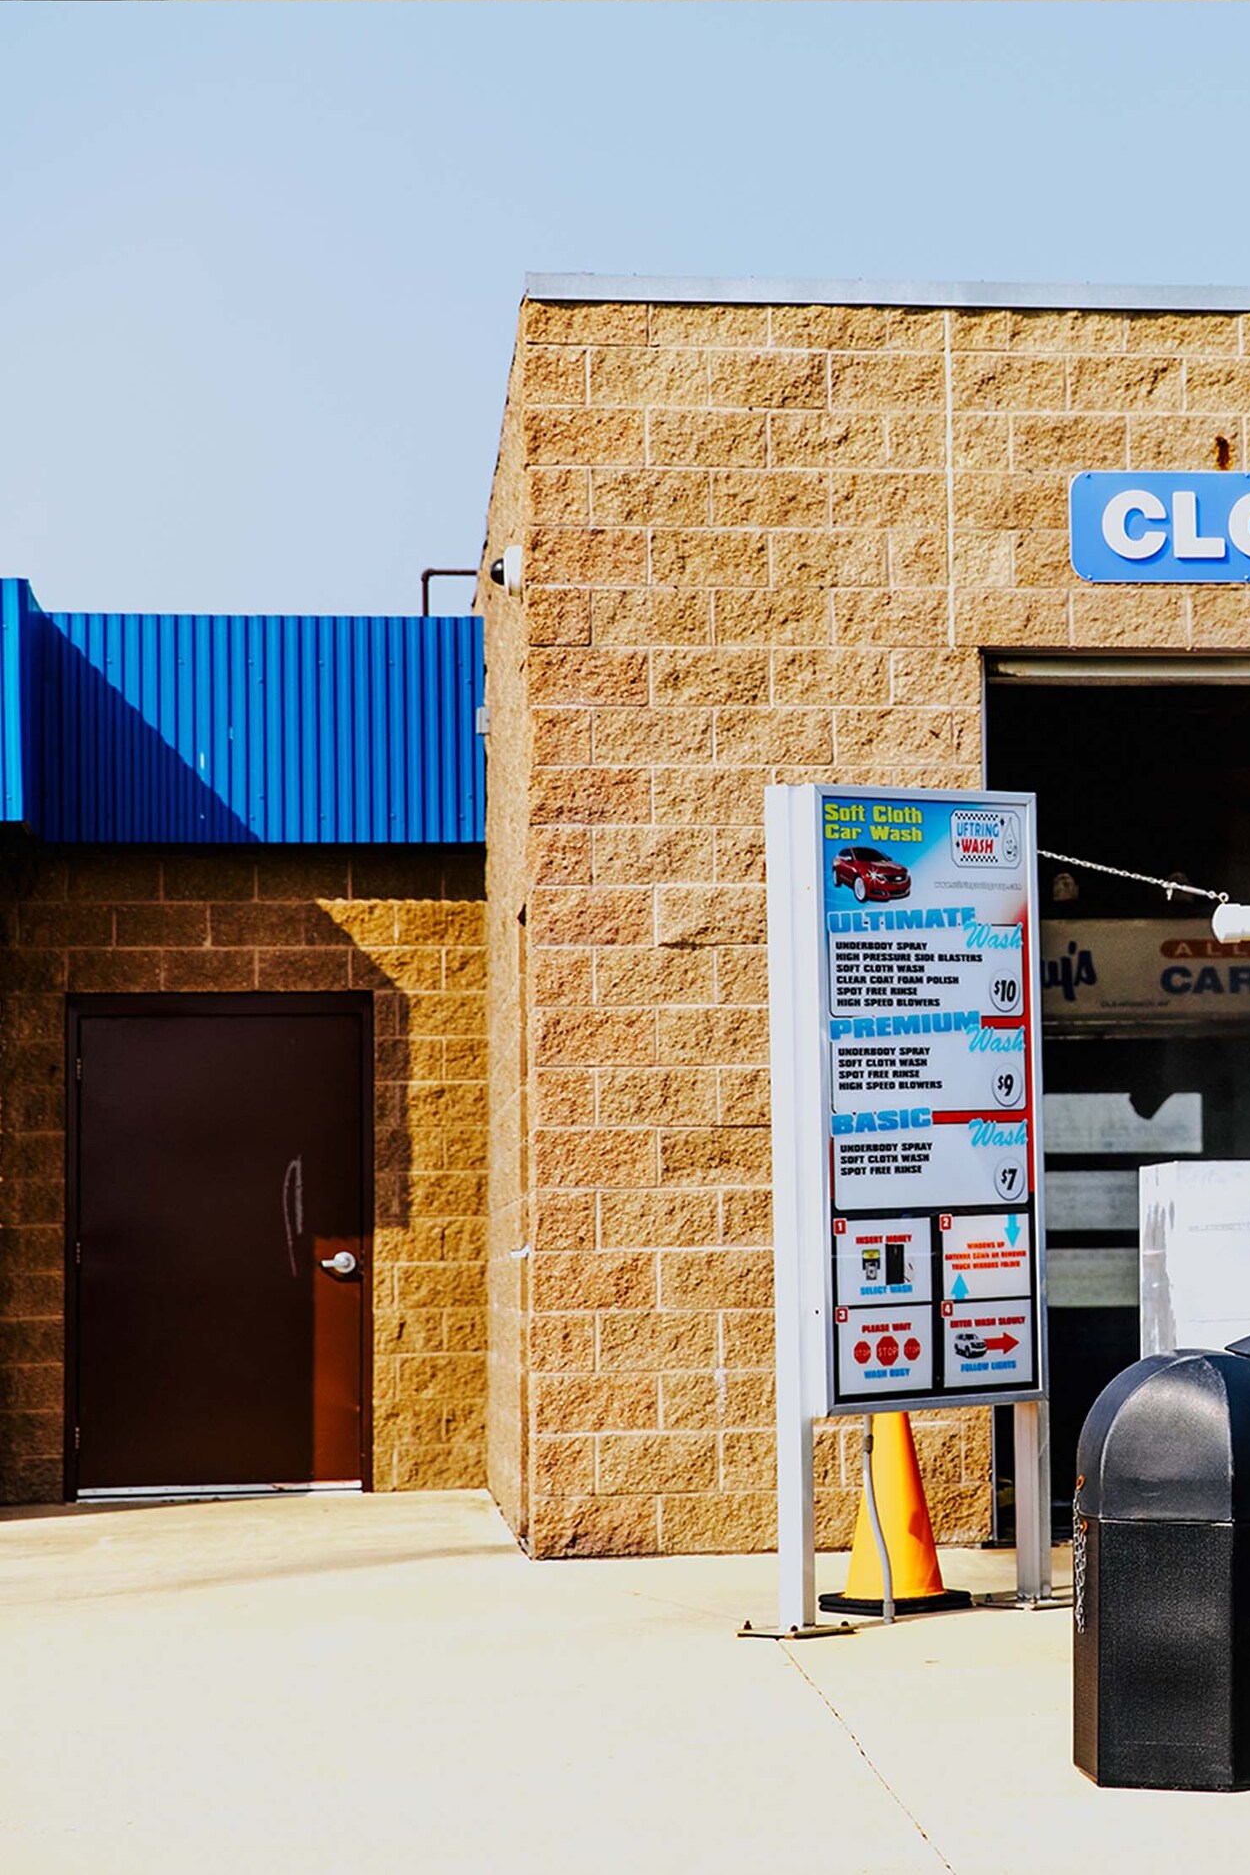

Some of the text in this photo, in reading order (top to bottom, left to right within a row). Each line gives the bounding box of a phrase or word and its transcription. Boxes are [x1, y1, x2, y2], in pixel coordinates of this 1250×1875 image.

[824, 804, 922, 824] Soft Cloth
[824, 824, 922, 842] Car Wash
[956, 823, 999, 837] UFTRING
[961, 839, 993, 854] WASH
[829, 907, 1023, 949] ULTIMATE Wash
[836, 942, 927, 950] UNDERBODY SPRAY
[1174, 940, 1247, 956] ALL
[863, 954, 911, 962] PRESSURE
[836, 964, 924, 973] SOFT CLOTH WASH
[837, 987, 862, 995] SPOT
[994, 980, 1016, 1002] $10
[830, 1011, 1026, 1053] PREMIUM Wash
[838, 1048, 896, 1056] UNDERBODY
[839, 1059, 862, 1067] SOFT
[839, 1071, 864, 1079] SPOT
[866, 1082, 896, 1090] SPEED
[899, 1081, 942, 1089] BLOWERS
[998, 1074, 1014, 1096] $9
[831, 1108, 1028, 1147] BASIC Wash
[840, 1143, 932, 1153] UNDERBODY SPRAY
[840, 1154, 930, 1164] SOFT CLOTH WASH
[841, 1167, 867, 1176] SPOT
[894, 1166, 922, 1174] RINSE
[1001, 1169, 1017, 1190] $7
[838, 1223, 842, 1231] 1
[944, 1217, 949, 1227] 2
[945, 1304, 950, 1314] 4
[840, 1310, 845, 1320] 3
[878, 1347, 898, 1356] STOP
